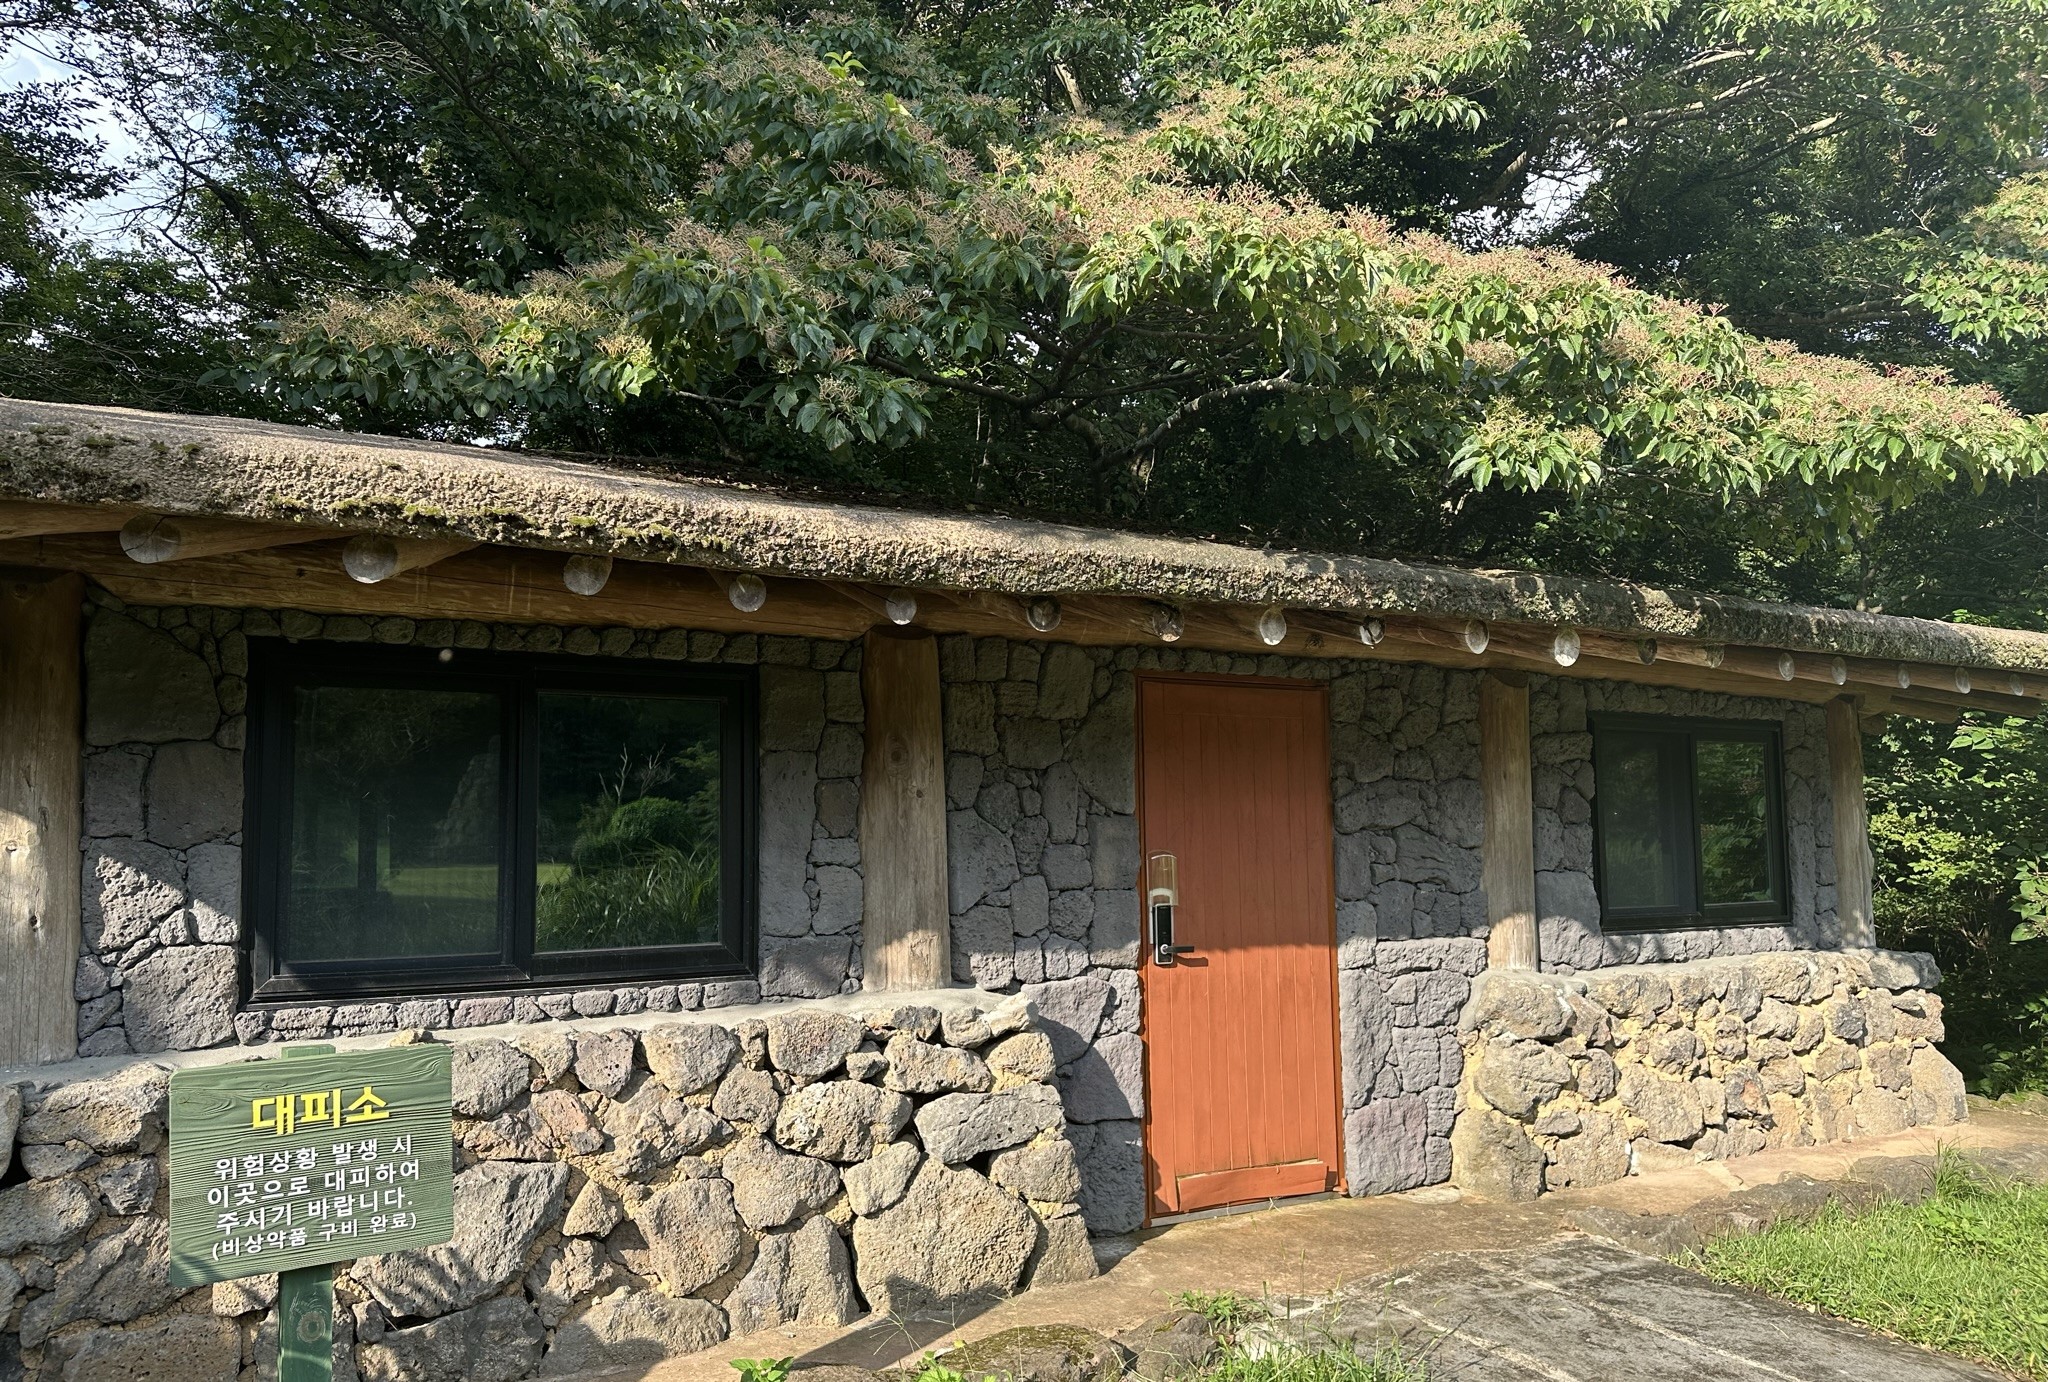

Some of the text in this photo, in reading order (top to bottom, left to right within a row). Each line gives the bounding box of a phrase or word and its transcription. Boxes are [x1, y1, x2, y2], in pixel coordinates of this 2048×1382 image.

[252, 1086, 390, 1135] 대피소
[215, 1134, 412, 1181] 위험상황 발생 시
[207, 1159, 420, 1208] 이곳으로 대피하여
[212, 1212, 418, 1260] (비상약품 구비 완료)
[216, 1187, 413, 1236] 주시기 바랍니다.
